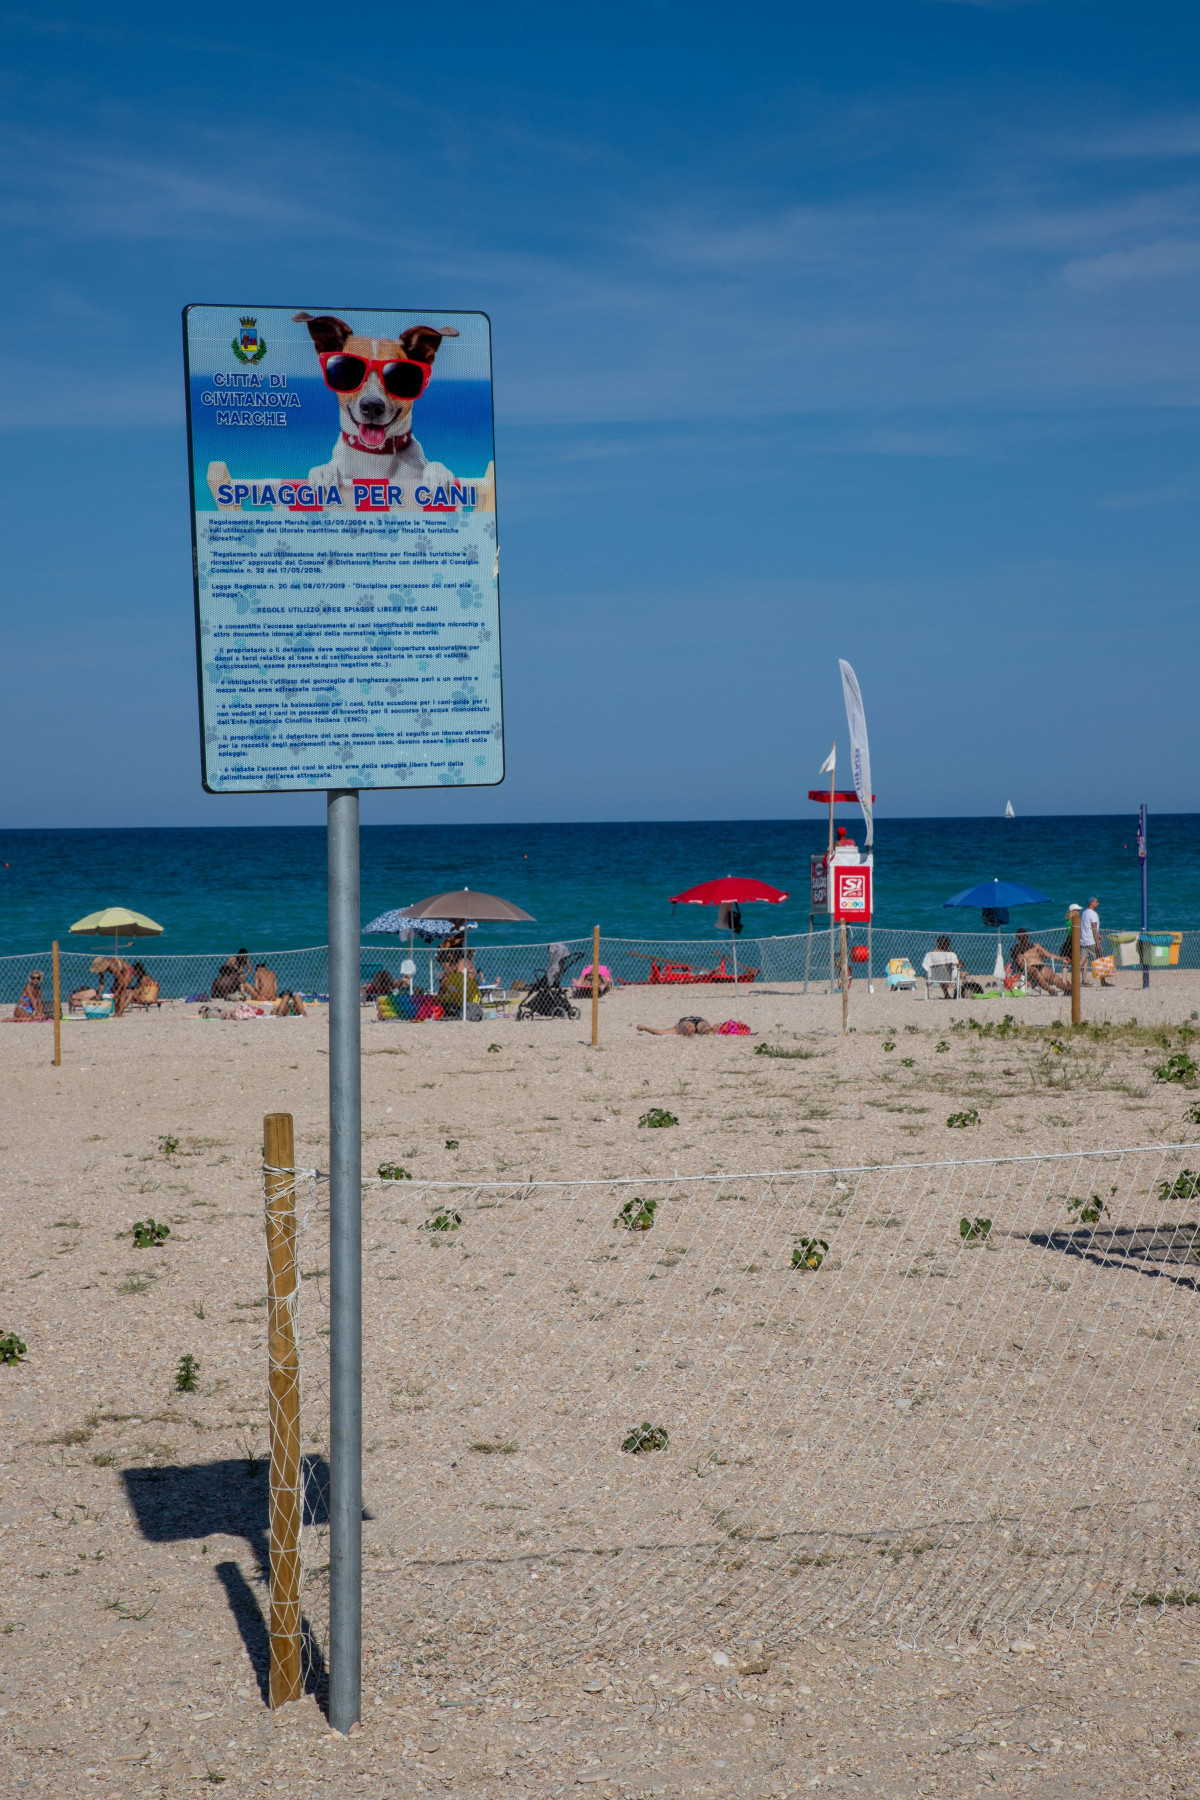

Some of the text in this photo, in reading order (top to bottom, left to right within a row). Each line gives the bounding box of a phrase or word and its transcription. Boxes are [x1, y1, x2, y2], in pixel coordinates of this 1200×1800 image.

[270, 374, 286, 388] DI
[201, 391, 301, 407] CIVITANOVA
[216, 411, 286, 426] MARCHE
[217, 484, 478, 506] SPIAGGIA PER CANI
[287, 662, 338, 670] parassitologico
